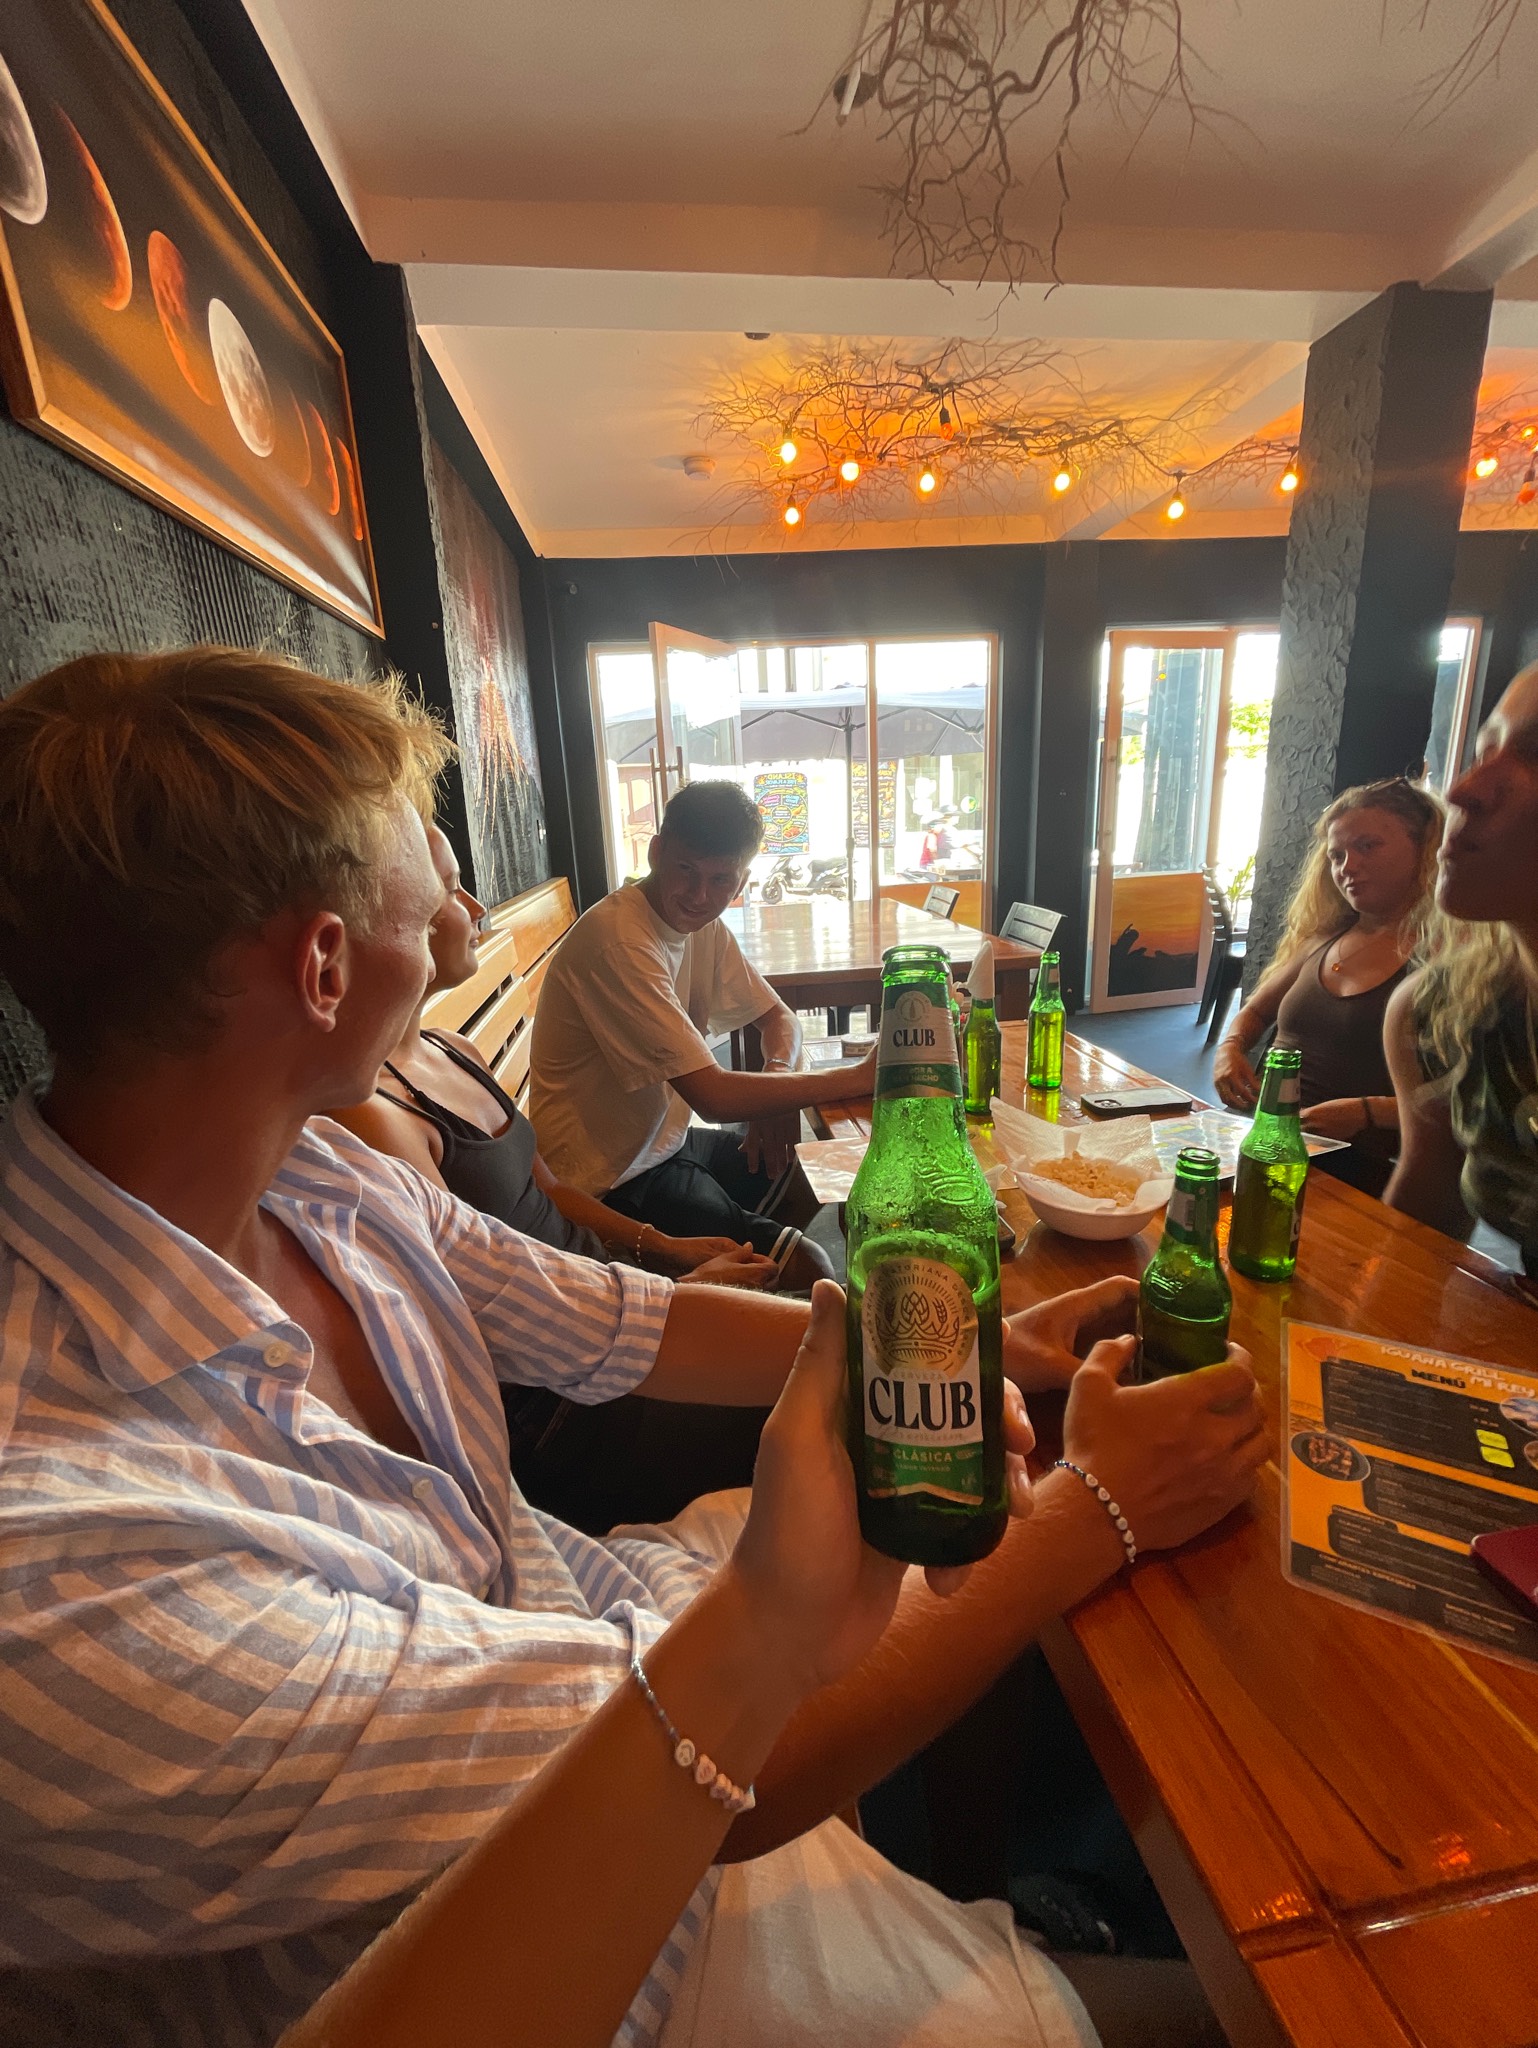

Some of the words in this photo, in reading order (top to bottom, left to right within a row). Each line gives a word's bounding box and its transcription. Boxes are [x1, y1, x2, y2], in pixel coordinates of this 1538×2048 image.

[893, 1028, 936, 1047] CLUB
[1381, 1346, 1447, 1369] IGUANA
[1450, 1361, 1506, 1381] GRILL
[1411, 1368, 1466, 1389] MENÚ
[1470, 1375, 1493, 1389] MI
[1497, 1382, 1537, 1399] REY
[868, 1376, 976, 1431] CLUB
[893, 1448, 953, 1462] CLÁSICA
